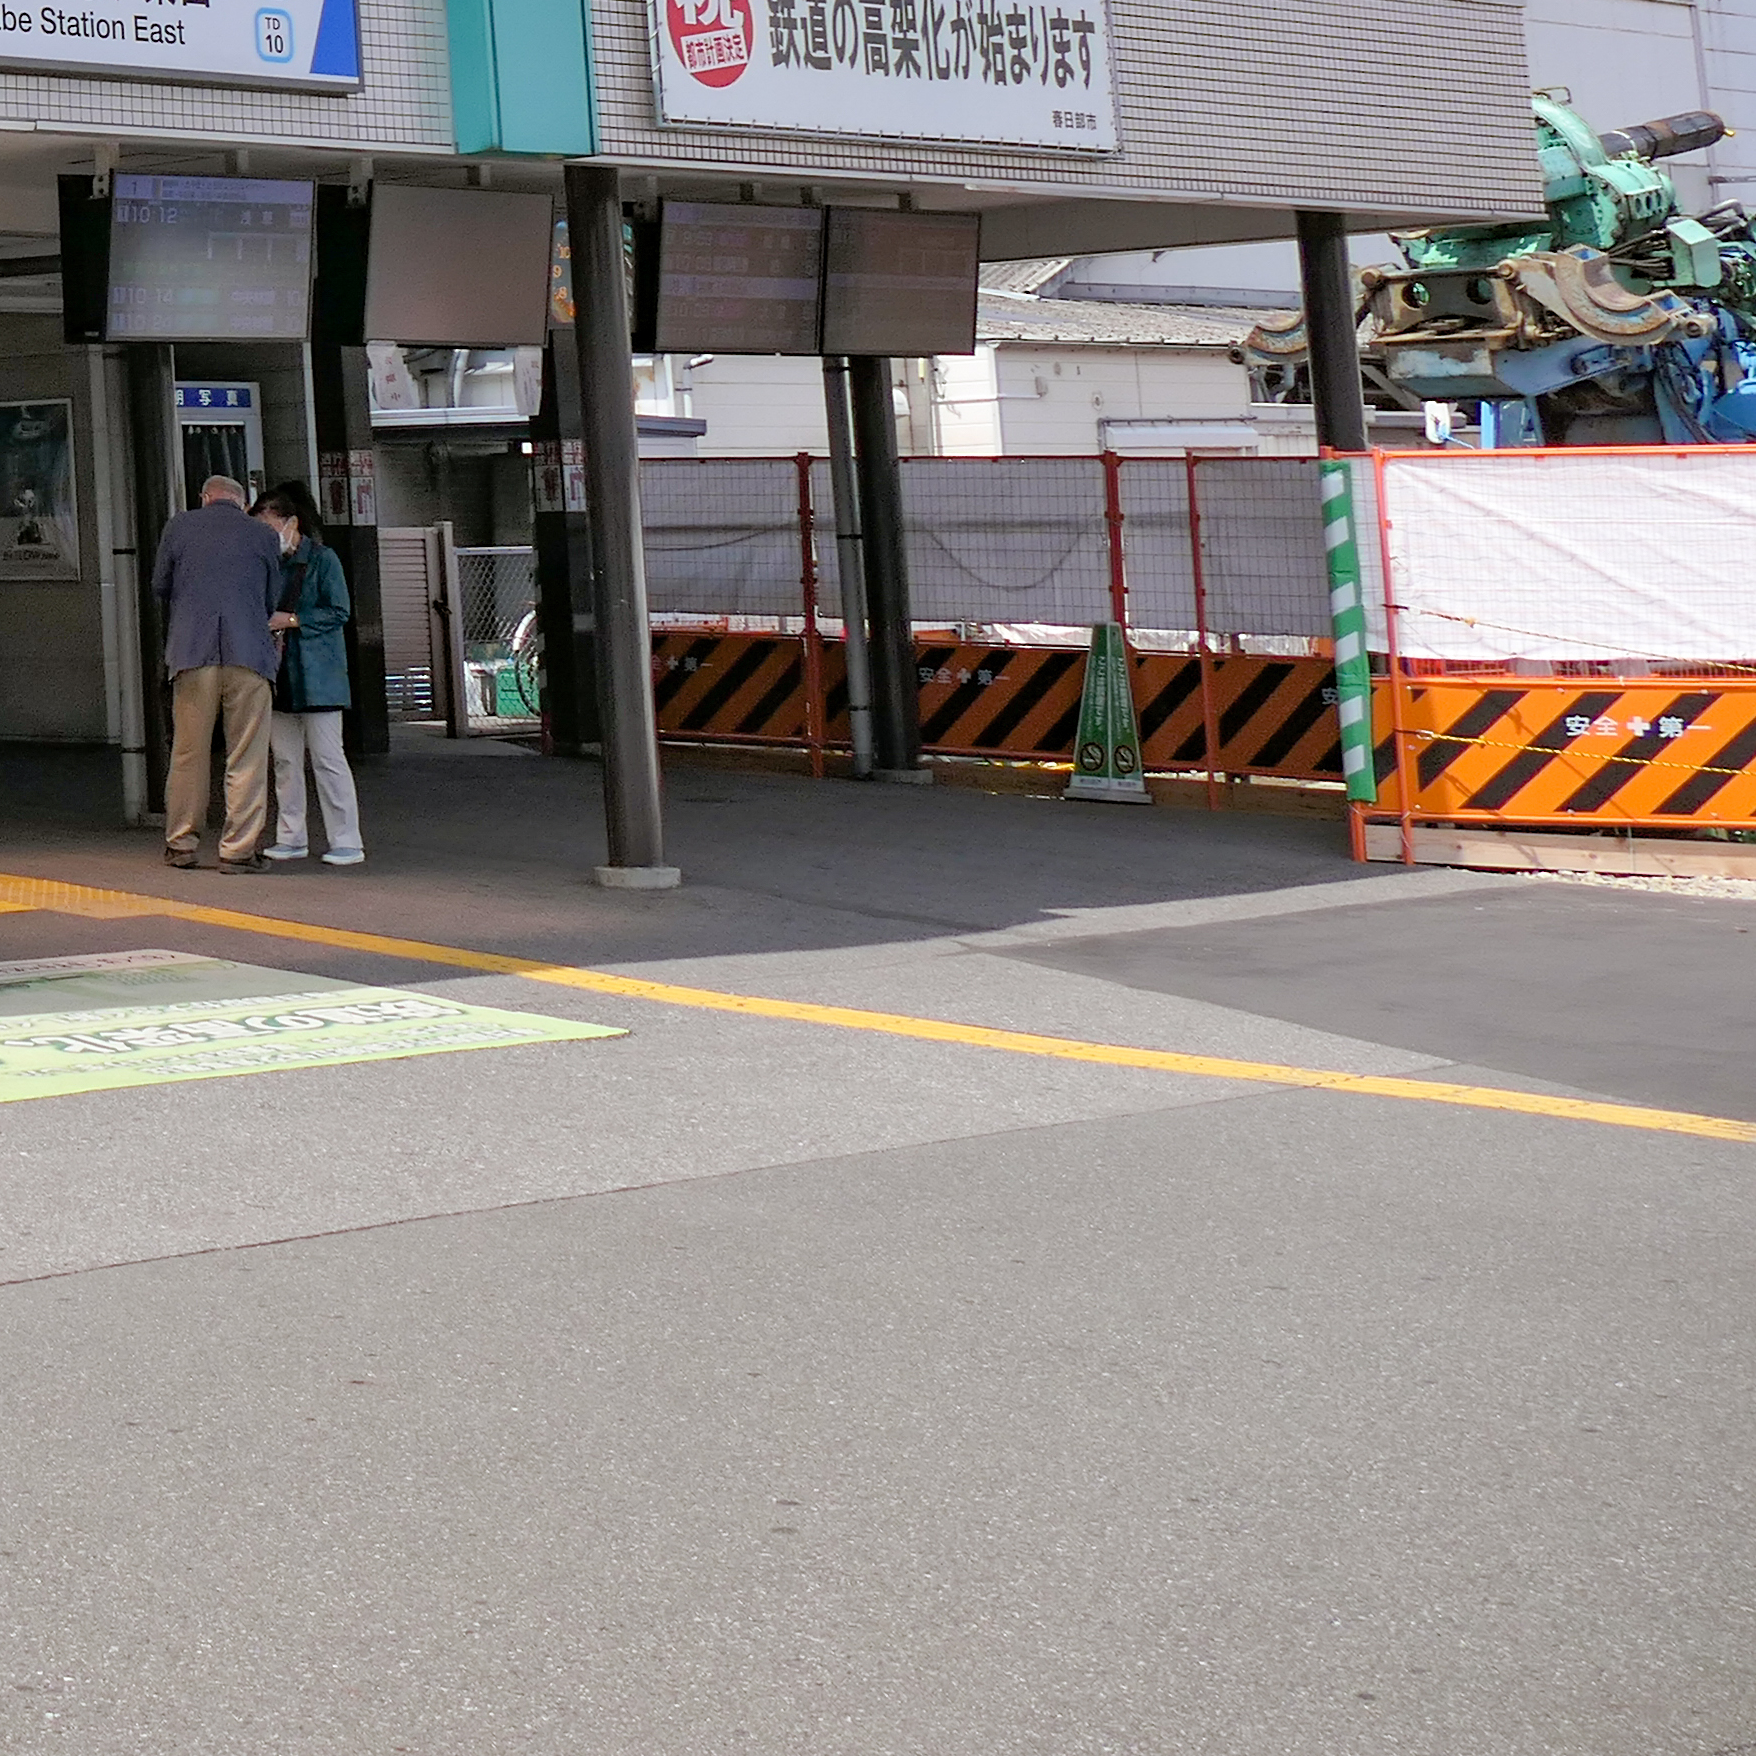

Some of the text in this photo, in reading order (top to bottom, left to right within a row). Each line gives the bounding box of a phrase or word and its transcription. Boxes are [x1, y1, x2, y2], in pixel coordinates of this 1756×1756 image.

[39, 7, 126, 42] Station
[134, 14, 186, 46] East
[264, 16, 282, 33] TD
[265, 33, 284, 55] 10
[684, 31, 746, 72] 都市計画決定
[1051, 109, 1098, 131] 春日部市
[684, 656, 714, 672] 第一
[918, 666, 1011, 686] 安全 第一
[1564, 713, 1712, 738] 安全 第一
